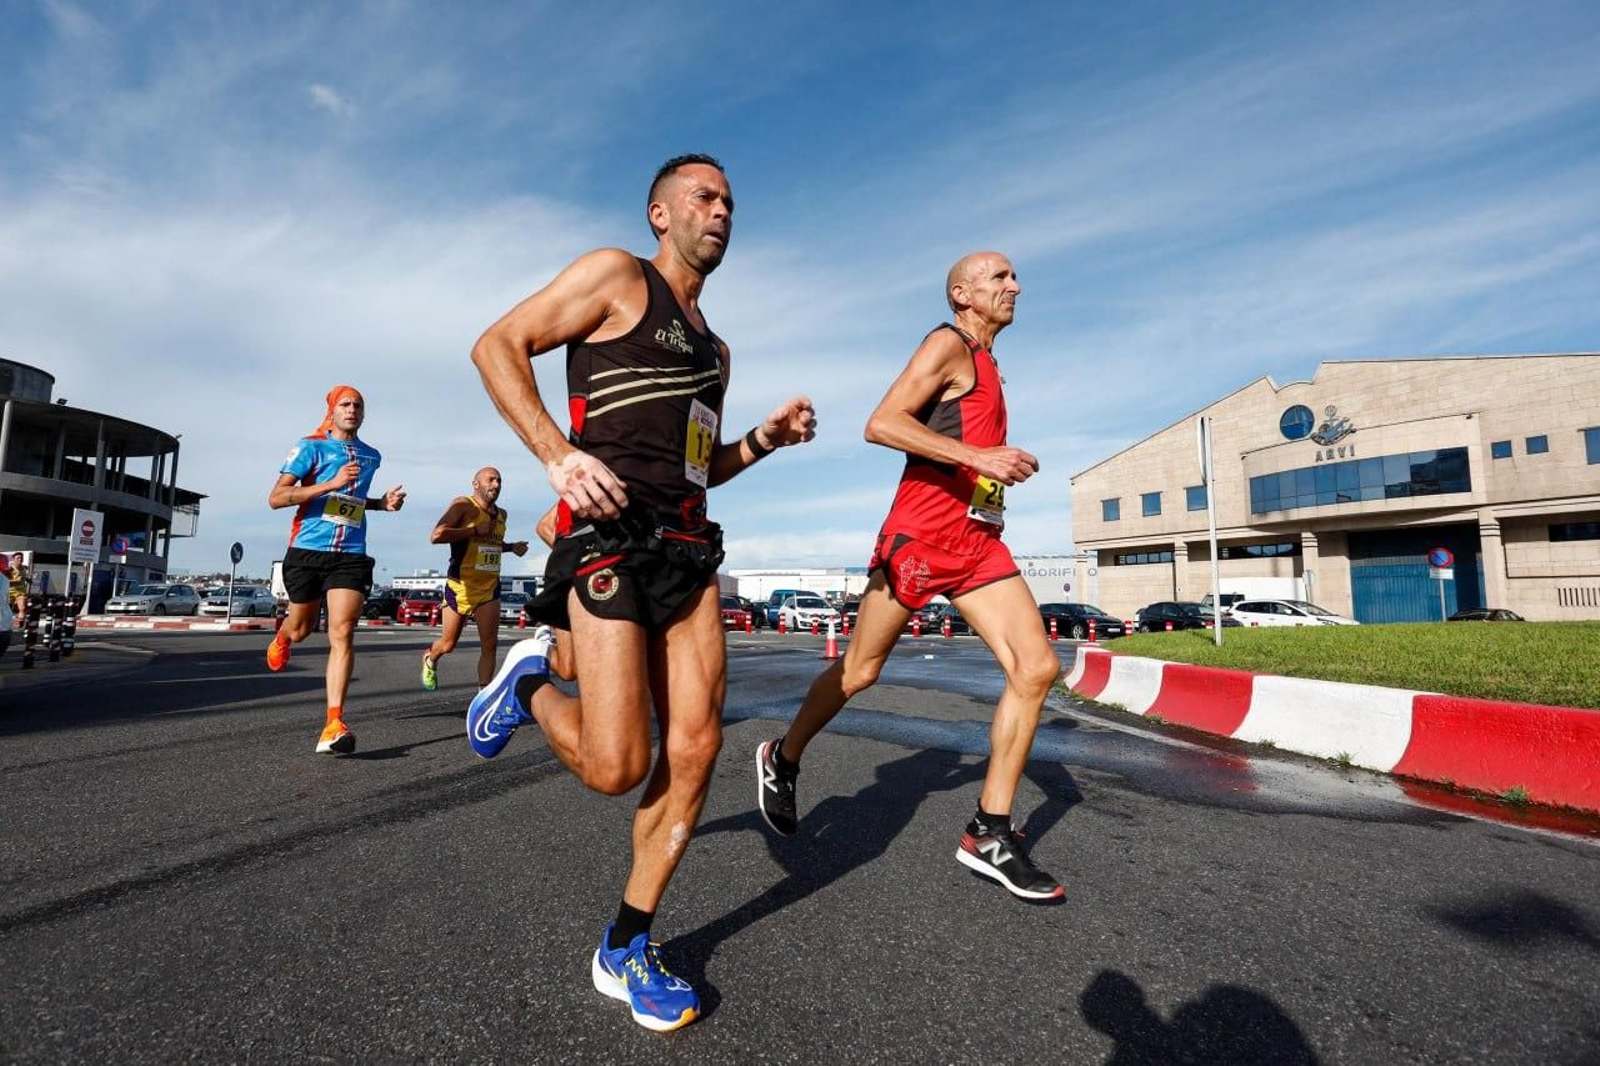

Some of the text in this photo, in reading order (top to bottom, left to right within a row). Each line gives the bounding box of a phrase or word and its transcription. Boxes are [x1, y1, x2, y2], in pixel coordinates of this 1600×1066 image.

[655, 329, 666, 342] El
[1315, 444, 1355, 462] ARVI
[339, 503, 357, 517] 67
